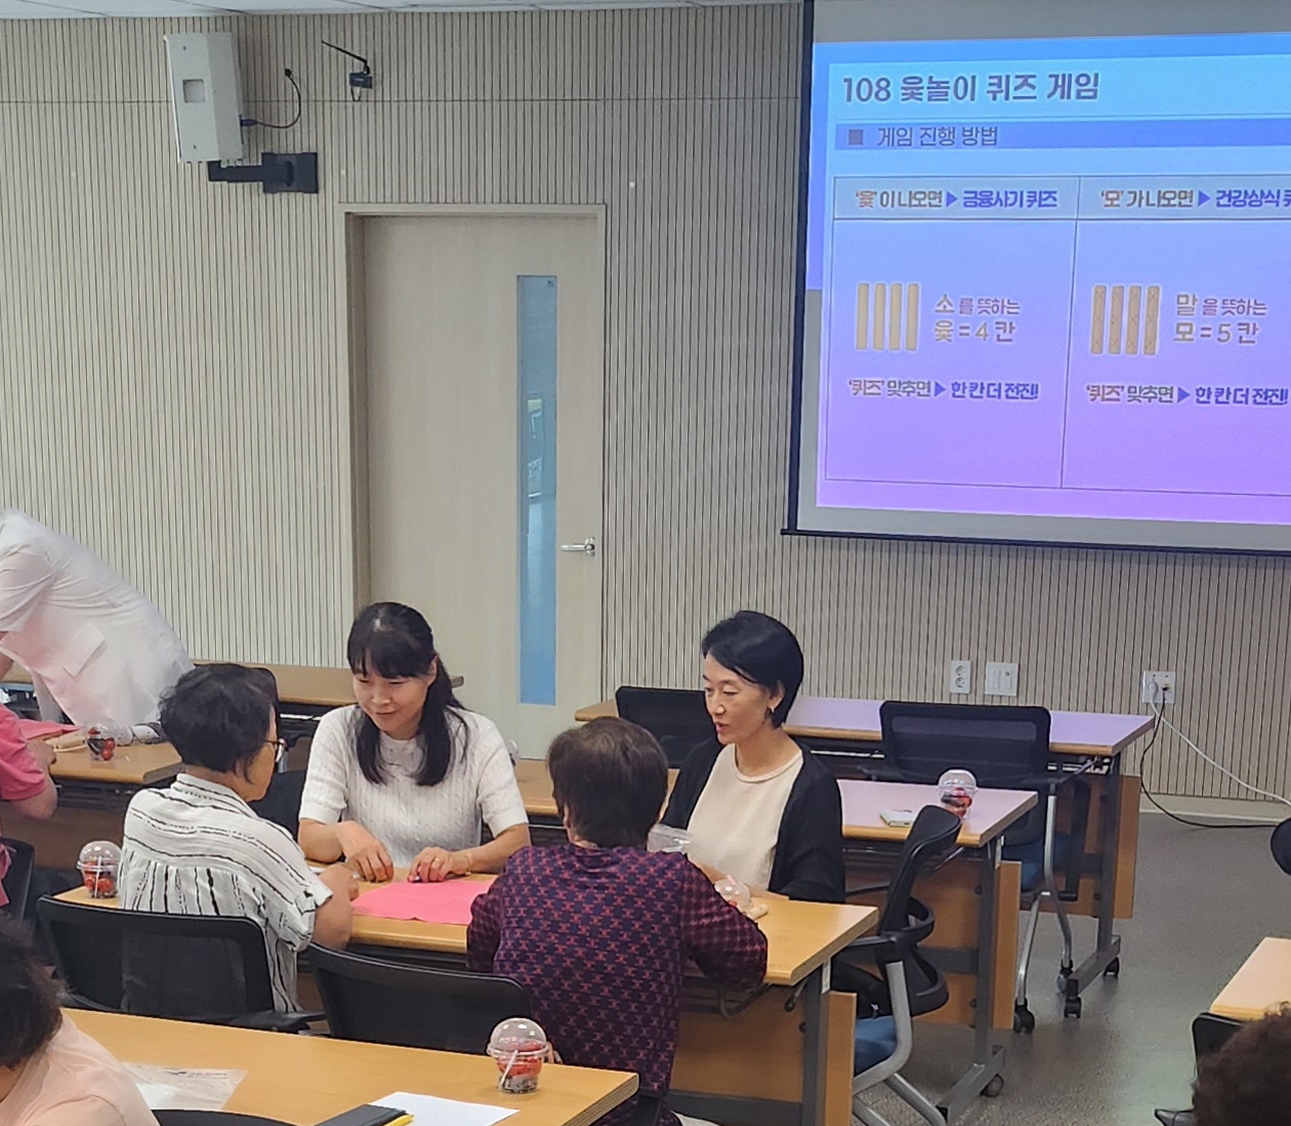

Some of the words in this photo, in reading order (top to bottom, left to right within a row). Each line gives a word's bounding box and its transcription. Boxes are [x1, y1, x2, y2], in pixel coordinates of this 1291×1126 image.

[842, 77, 892, 102] 108
[900, 74, 977, 102] 윷놀이
[986, 74, 1038, 102] 퀴즈
[1046, 72, 1100, 100] 게임
[877, 127, 913, 147] 게임
[919, 126, 957, 147] 진행
[962, 126, 999, 146] 방법
[962, 189, 1024, 208] 금융사기
[1026, 189, 1058, 208] 퀴즈
[1215, 189, 1281, 208] 건강상식
[934, 294, 955, 314] 소
[977, 297, 1021, 315] 뜻하는
[1175, 293, 1198, 316] 말
[1202, 298, 1218, 316] 을
[1221, 298, 1268, 316] 뜻하는
[975, 321, 989, 342] 4
[994, 321, 1016, 343] 칸
[1174, 322, 1195, 342] 모
[1217, 323, 1232, 343] 5
[1237, 322, 1259, 344] 칸
